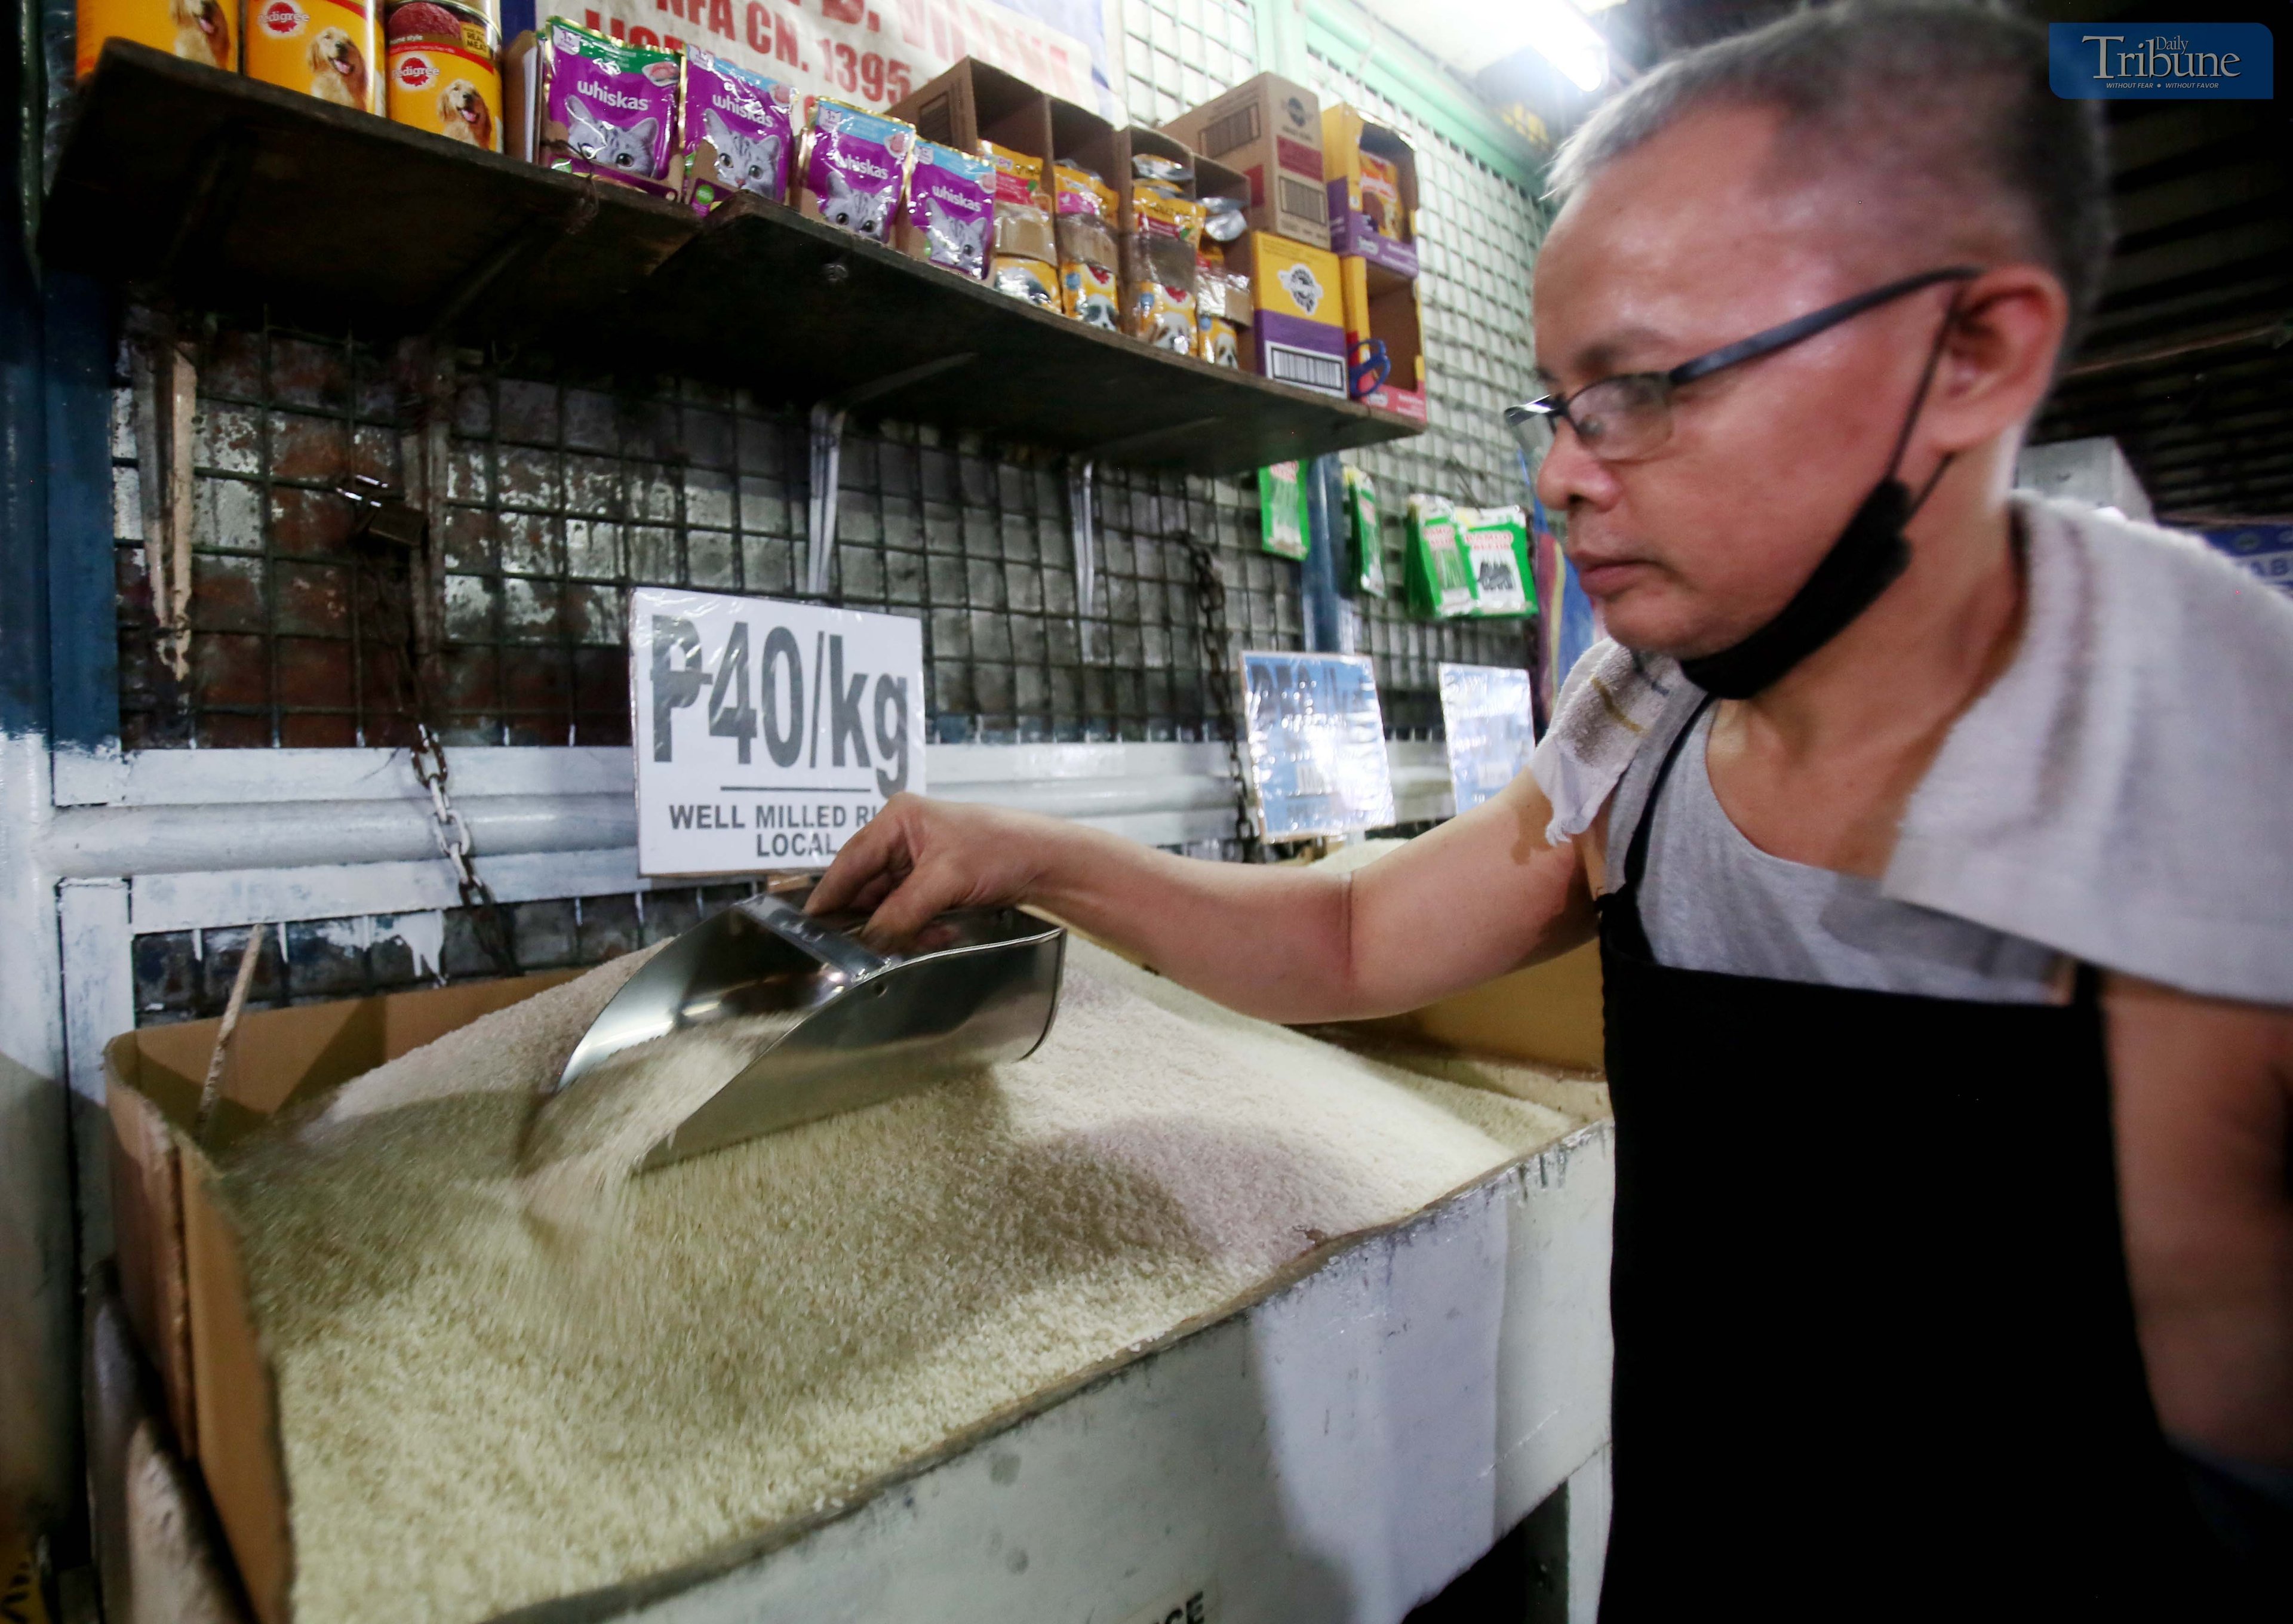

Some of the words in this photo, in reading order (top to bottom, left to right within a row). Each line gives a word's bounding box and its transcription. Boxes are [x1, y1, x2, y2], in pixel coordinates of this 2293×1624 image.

[746, 1, 809, 72] CN.
[816, 38, 911, 106] 1395
[577, 80, 649, 112] whiskas
[932, 185, 982, 211] whiskas
[669, 804, 745, 829] WELL
[755, 805, 846, 828] MILLED
[757, 833, 838, 857] LOCAL
